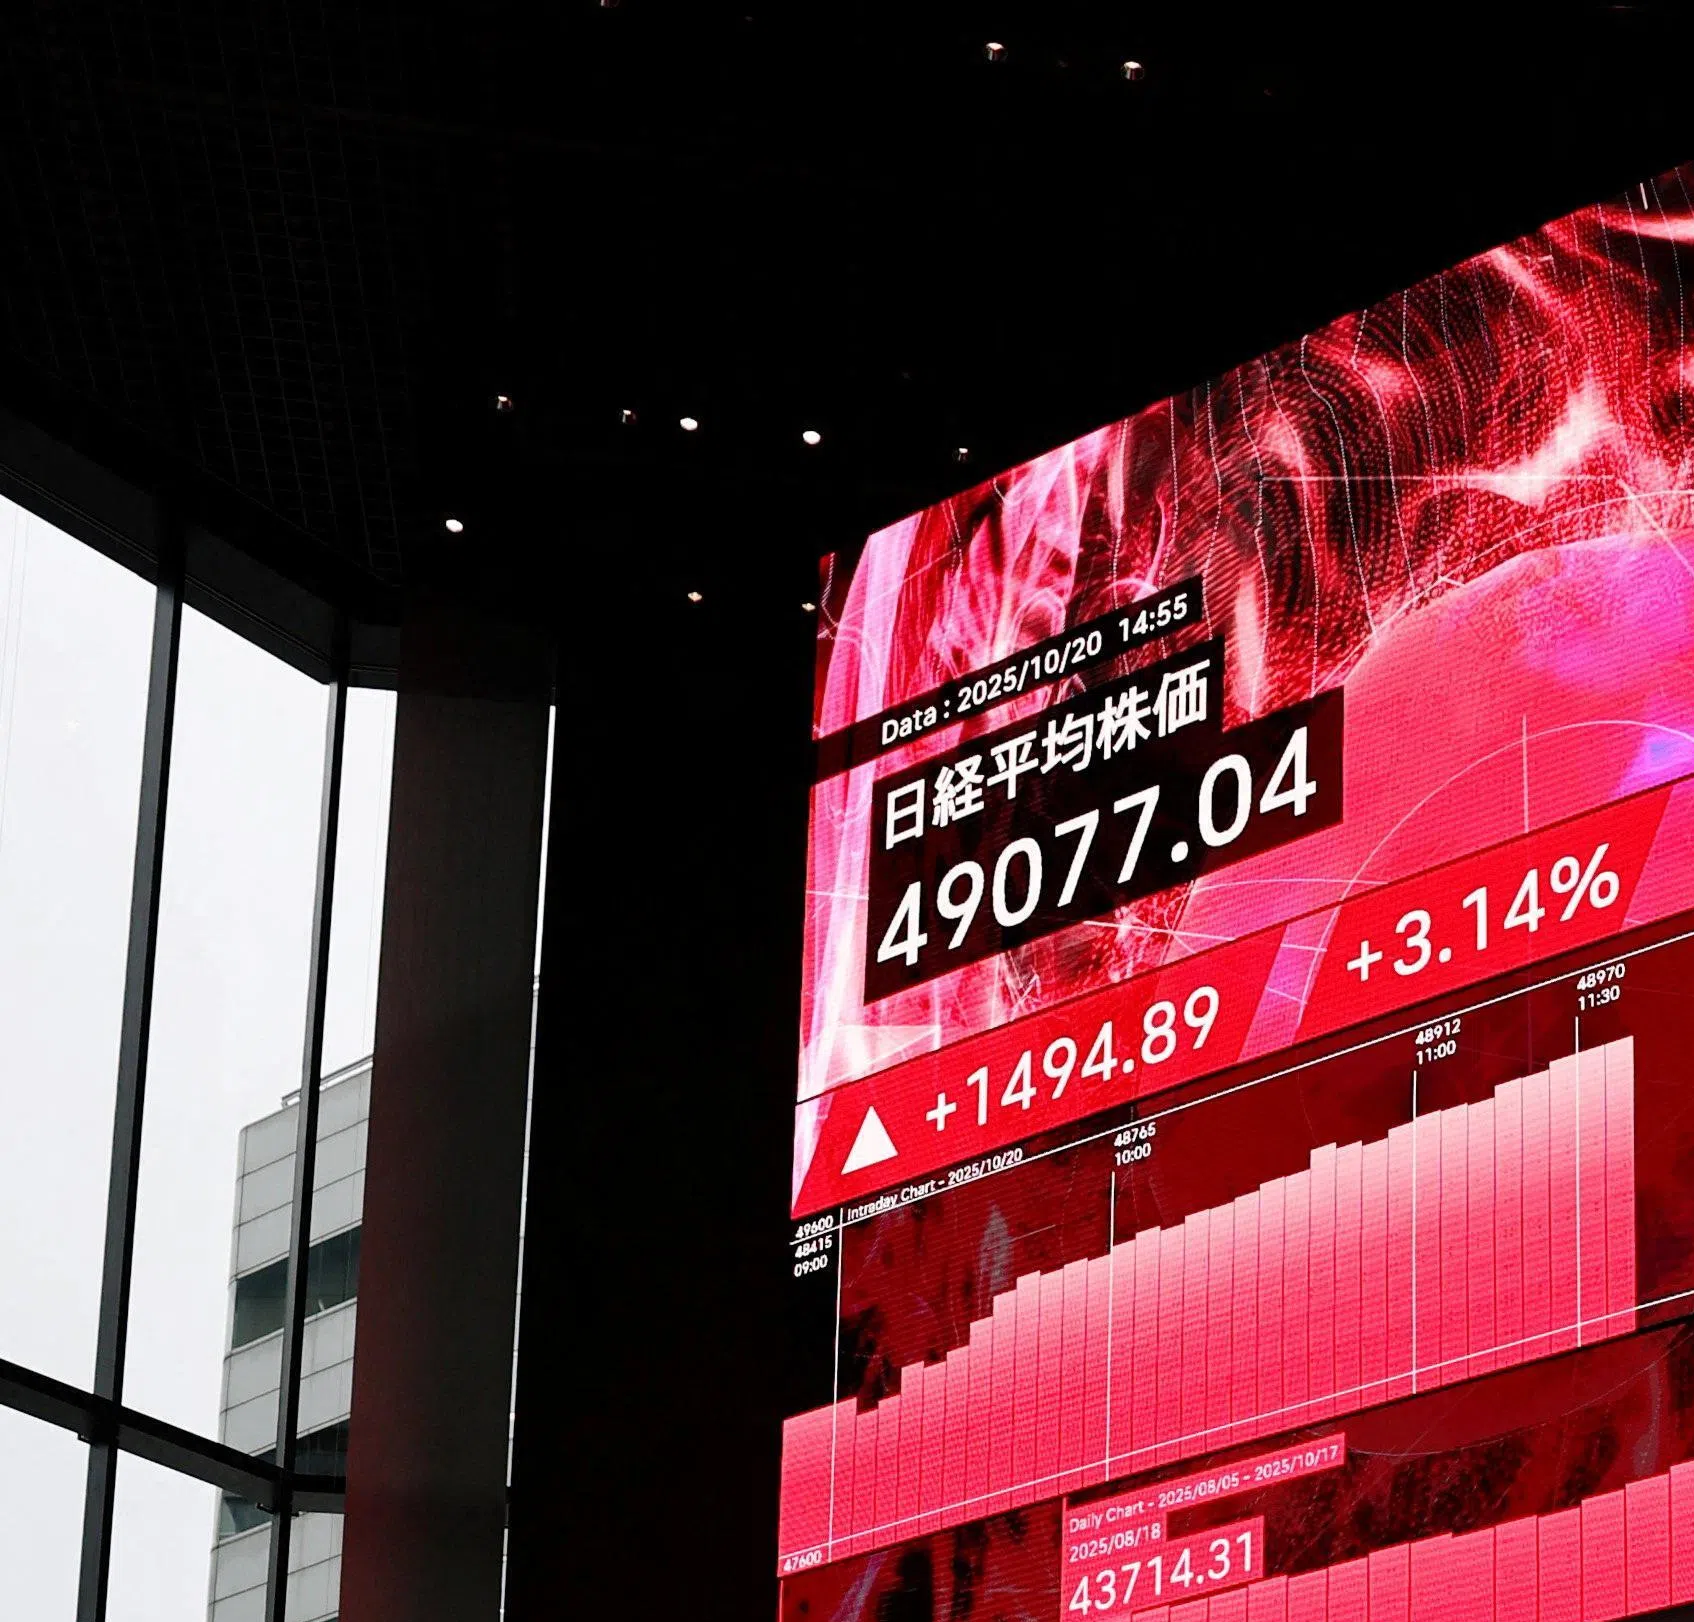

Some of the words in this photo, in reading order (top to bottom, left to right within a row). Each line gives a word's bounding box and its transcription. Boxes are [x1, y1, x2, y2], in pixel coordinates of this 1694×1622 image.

[881, 705, 937, 745] Data
[957, 630, 1102, 715] 2025/10/20
[1118, 593, 1188, 641] 14:55
[885, 659, 1212, 850] 日経平均株価
[875, 725, 1317, 968] 49077.04
[1347, 843, 1620, 982] +3.14%
[1576, 963, 1626, 992] 48970
[1577, 984, 1621, 1011] 11:30
[1414, 1018, 1462, 1048] 48912
[926, 985, 1221, 1132] +1494.89
[1415, 1039, 1457, 1065] 11:00
[1113, 1123, 1156, 1148] 48765
[1114, 1142, 1152, 1167] 10:00
[848, 1192, 898, 1221] Intraday
[901, 1179, 936, 1202] Chart
[948, 1147, 1023, 1186] 2025/10/20
[795, 1215, 834, 1238] 49600
[794, 1235, 833, 1259] 48415
[793, 1254, 828, 1278] 09:00
[1069, 1513, 1101, 1533] Daily
[1105, 1503, 1145, 1522] Chart
[1158, 1472, 1239, 1508] 2025/08/05
[1254, 1445, 1338, 1482] 2025/10/17
[1069, 1522, 1161, 1563] 2025/08/18
[784, 1549, 822, 1571] 47600
[1068, 1531, 1252, 1616] 43714.31
